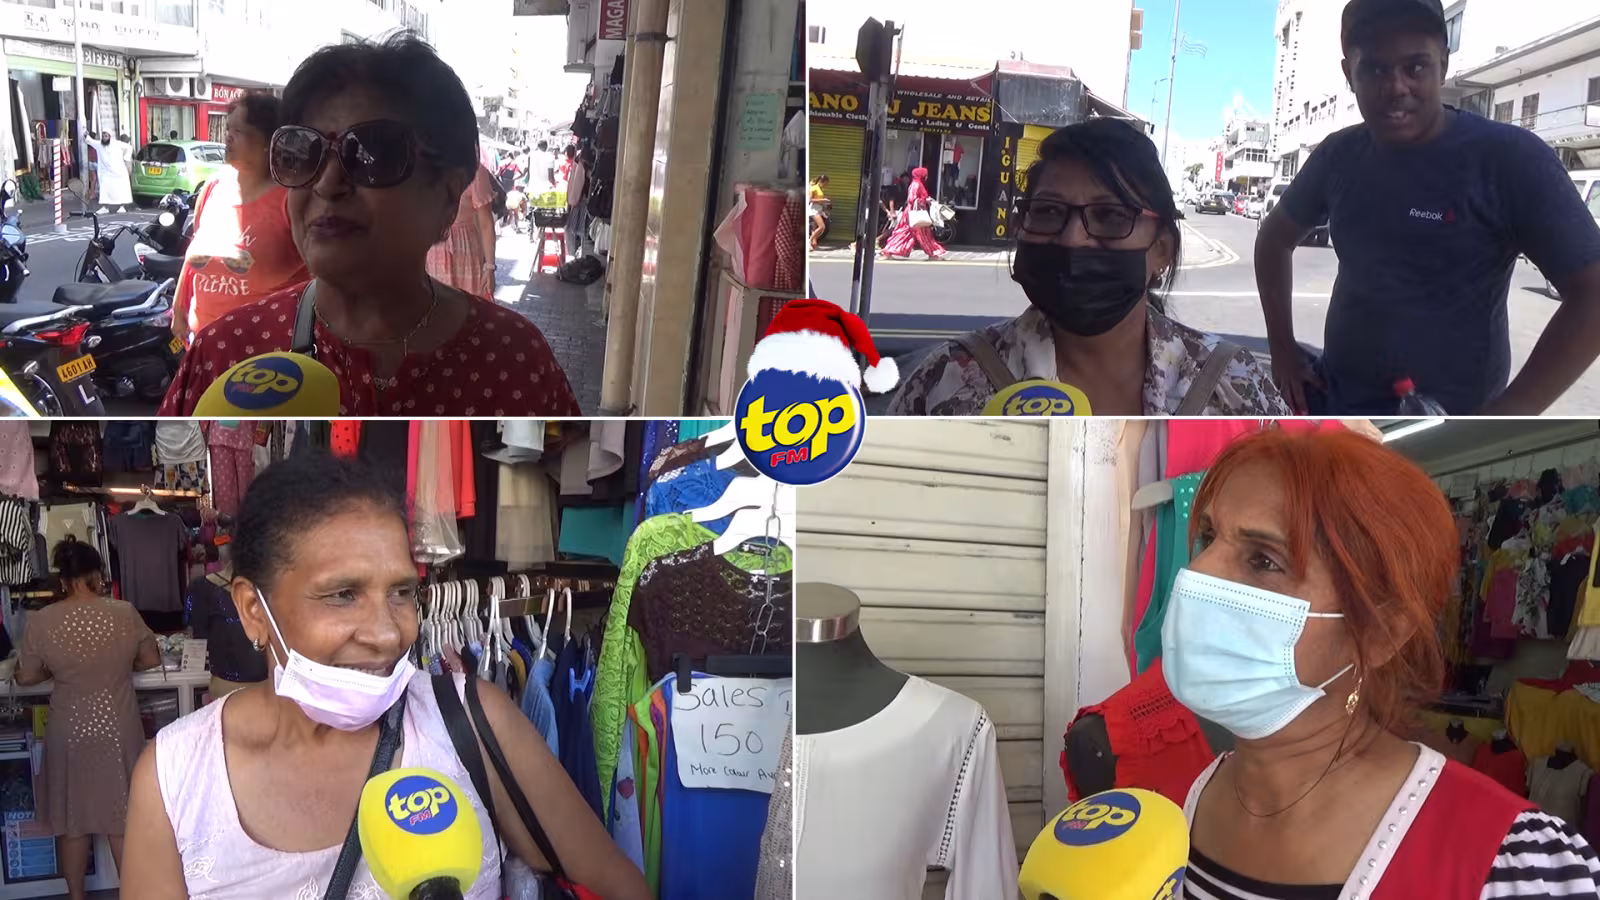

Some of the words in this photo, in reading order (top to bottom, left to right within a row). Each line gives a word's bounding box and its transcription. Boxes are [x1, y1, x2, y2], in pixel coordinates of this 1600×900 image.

[605, 0, 625, 39] MAGA
[82, 50, 121, 67] EIFFEL
[897, 90, 942, 98] WHOLESALE
[809, 92, 858, 111] ANO
[912, 102, 991, 122] JEANS
[900, 117, 918, 125] Kids
[926, 119, 950, 127] Ladies
[996, 136, 1011, 237] IGUANO
[1409, 208, 1443, 220] Reebok
[198, 274, 250, 296] PLEASE
[231, 363, 299, 394] top
[1006, 395, 1072, 416] top
[674, 683, 768, 712] Sales
[701, 722, 764, 756] 150
[690, 763, 717, 776] More
[388, 786, 450, 820] top
[1061, 800, 1136, 831] top
[409, 809, 431, 827] FM
